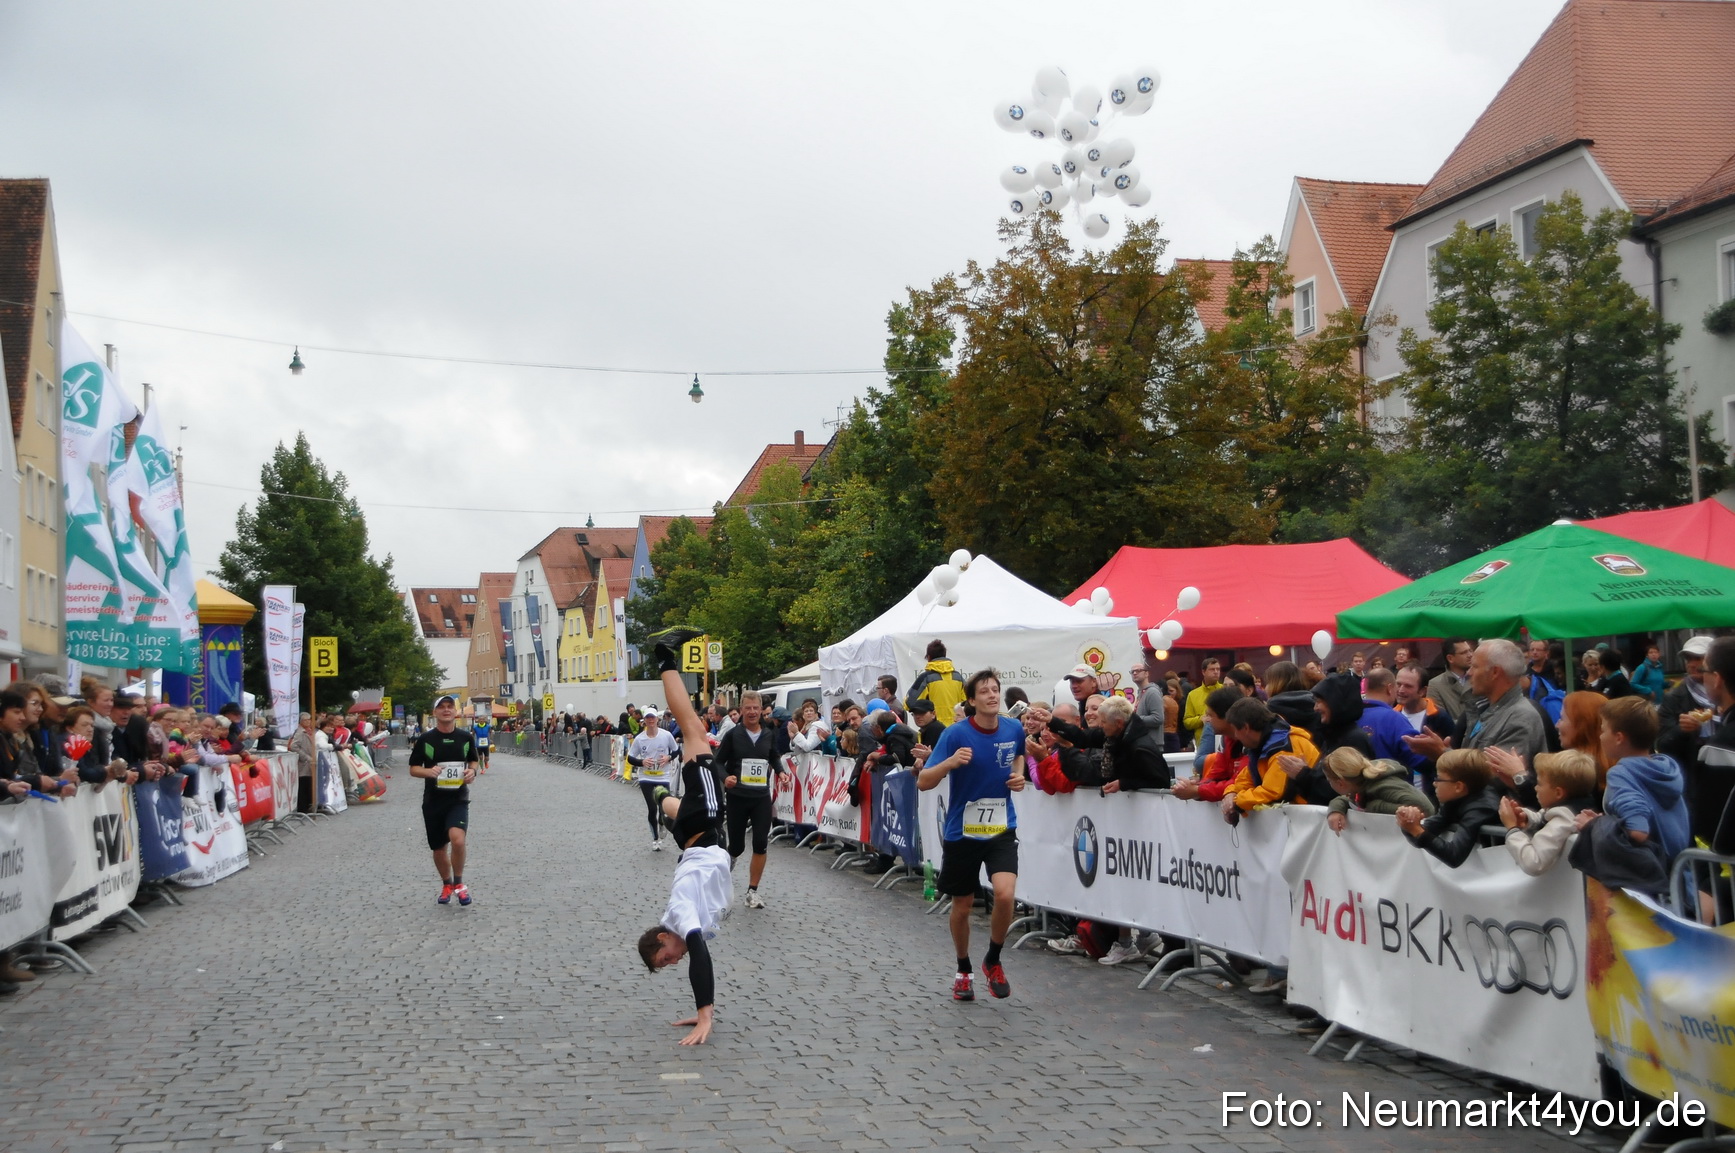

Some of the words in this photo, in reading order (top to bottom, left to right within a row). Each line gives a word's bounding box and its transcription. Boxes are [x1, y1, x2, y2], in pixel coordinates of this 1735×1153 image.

[1597, 579, 1692, 590] Neumarkter
[1590, 586, 1724, 602] Lammsbräu
[136, 633, 171, 647] Line:
[313, 639, 335, 647] Block
[317, 649, 332, 668] B
[689, 645, 702, 664] B
[1020, 666, 1042, 679] Sie.
[382, 702, 389, 711] C
[545, 698, 552, 707] C
[447, 768, 458, 779] 84
[751, 765, 762, 776] 56
[977, 808, 994, 823] 77
[1105, 836, 1153, 881] BMW
[1157, 842, 1241, 904] Laufsport
[1300, 879, 1367, 945] Audi
[1377, 897, 1465, 973] BKK
